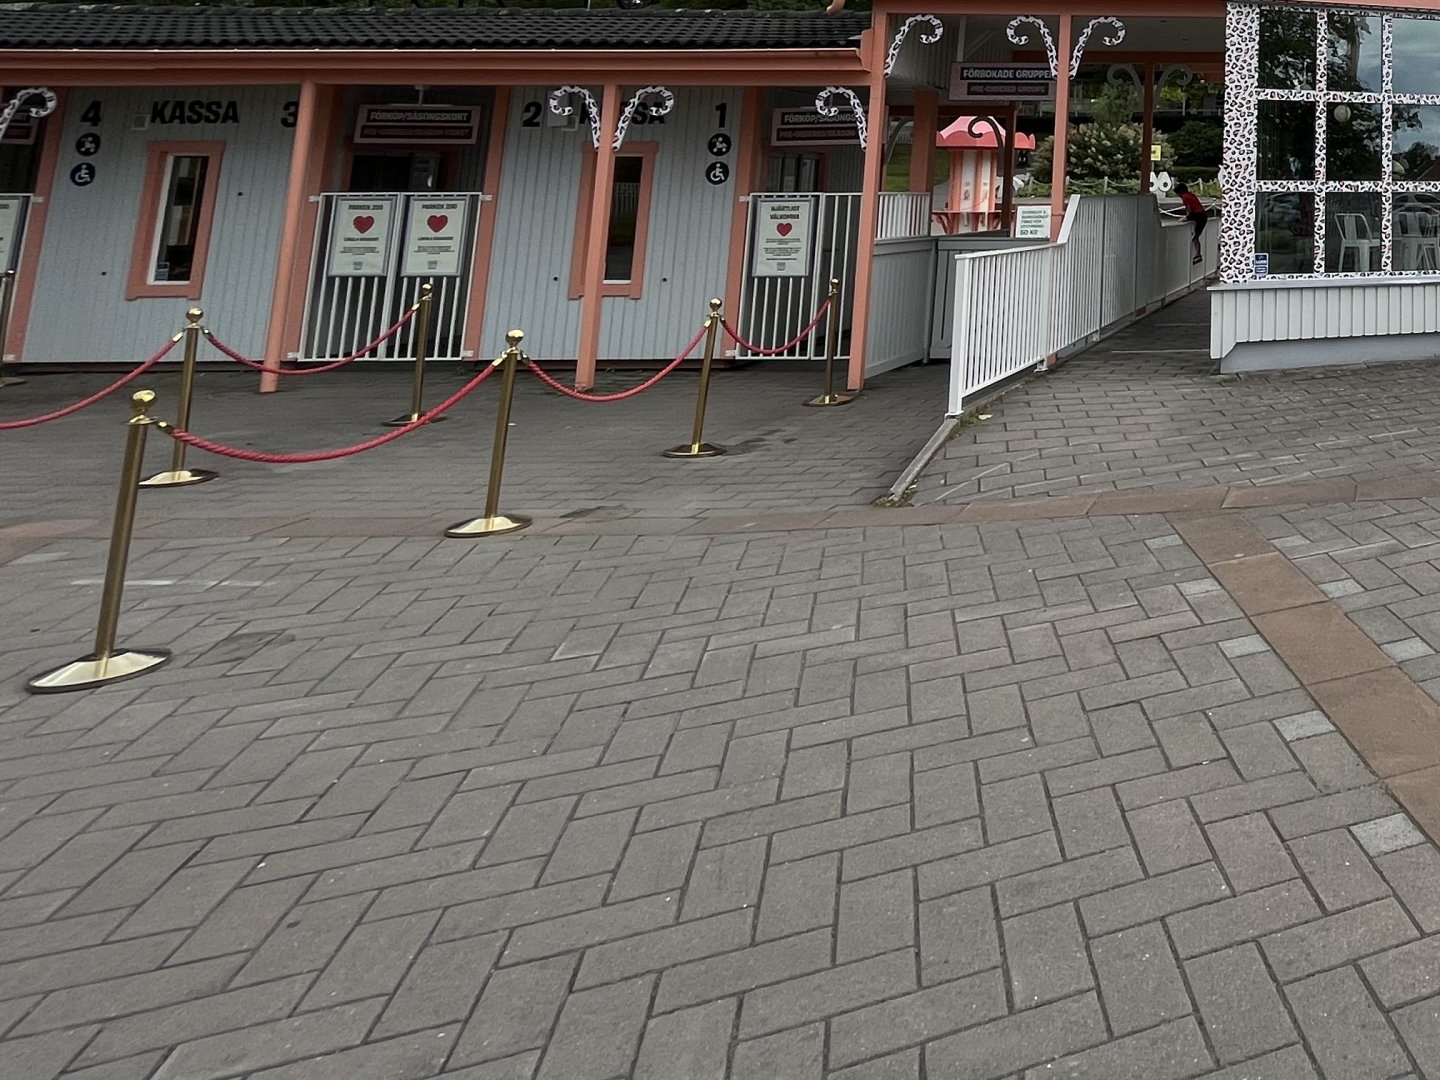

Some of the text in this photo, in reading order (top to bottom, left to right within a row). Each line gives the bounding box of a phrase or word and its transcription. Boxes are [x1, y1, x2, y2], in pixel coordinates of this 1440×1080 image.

[963, 68, 1014, 79] FÖRBOKADE
[80, 100, 299, 128] 4 KASSA 3
[522, 101, 544, 128] 2
[714, 102, 728, 128] 1
